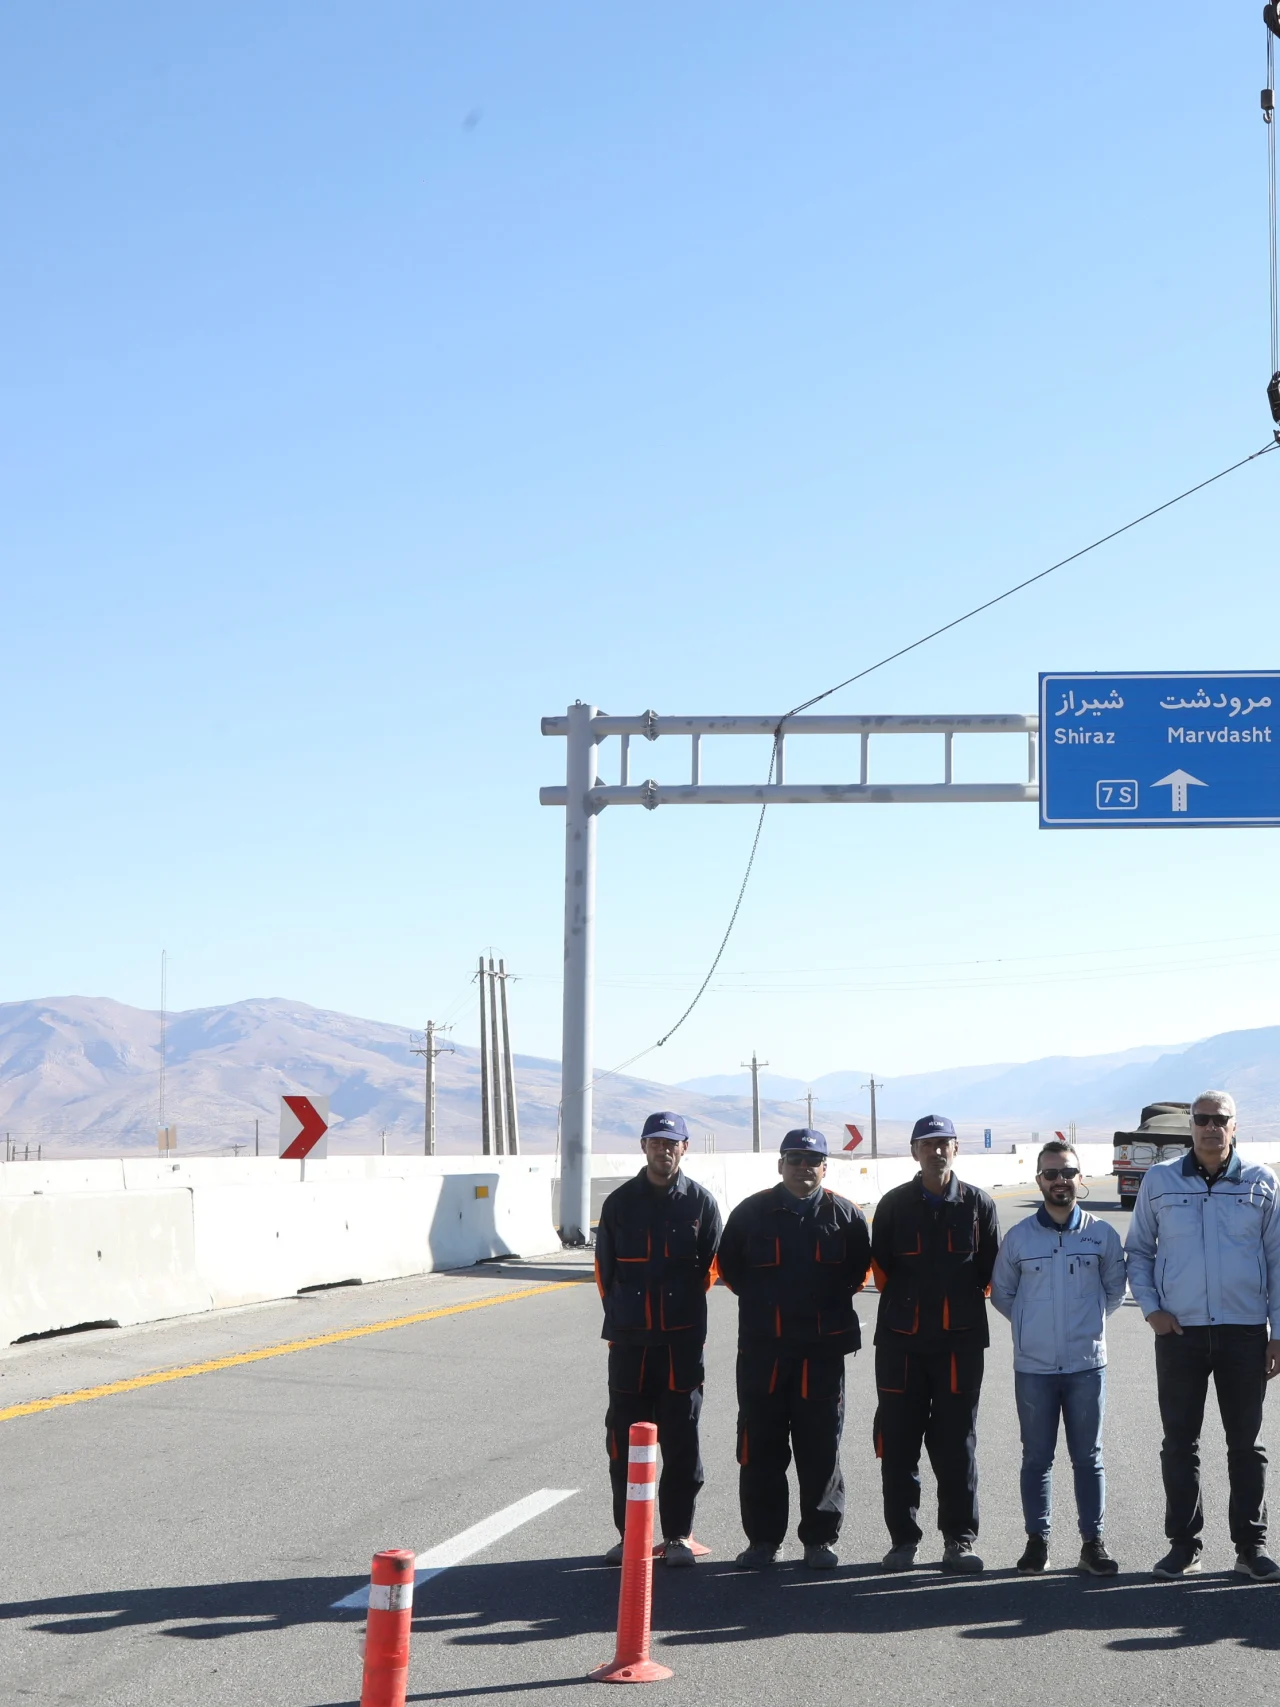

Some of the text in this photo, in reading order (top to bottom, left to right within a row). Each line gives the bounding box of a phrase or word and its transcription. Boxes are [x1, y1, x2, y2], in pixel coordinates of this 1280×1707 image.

[1055, 689, 1124, 717] شیراز
[1159, 688, 1272, 717] مرودشت
[1054, 727, 1115, 745] Shiraz
[1168, 726, 1272, 744] Marvdasht
